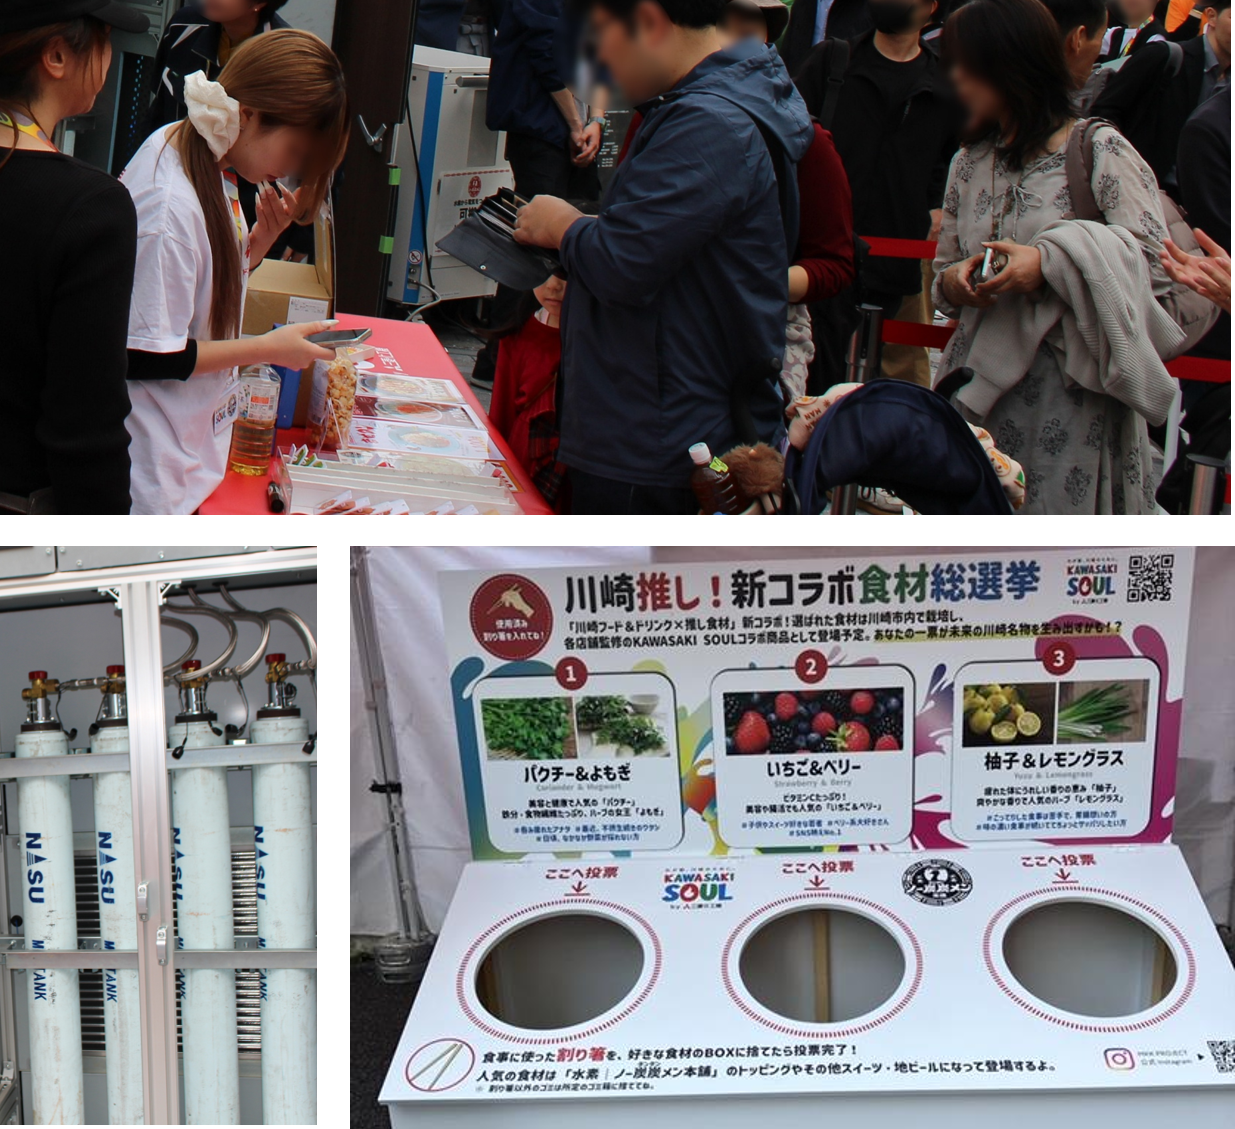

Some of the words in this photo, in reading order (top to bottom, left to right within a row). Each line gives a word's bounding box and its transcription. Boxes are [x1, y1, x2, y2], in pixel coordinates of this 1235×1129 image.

[1067, 563, 1118, 575] KAWASAKI
[1067, 575, 1116, 596] SOUL
[1053, 650, 1065, 666] 3
[566, 666, 577, 682] 1
[805, 658, 817, 675] 2
[536, 783, 574, 792] Coriander
[774, 779, 817, 788] Strawberry
[831, 778, 852, 787] Berry
[26, 832, 47, 904] NASU
[98, 832, 117, 904] NASU
[781, 860, 854, 874] ここへ投票
[1021, 853, 1096, 868] ここへ投票
[545, 865, 619, 880] ここへ投票
[663, 872, 735, 883] KAWASAKI
[662, 883, 733, 902] SOUL
